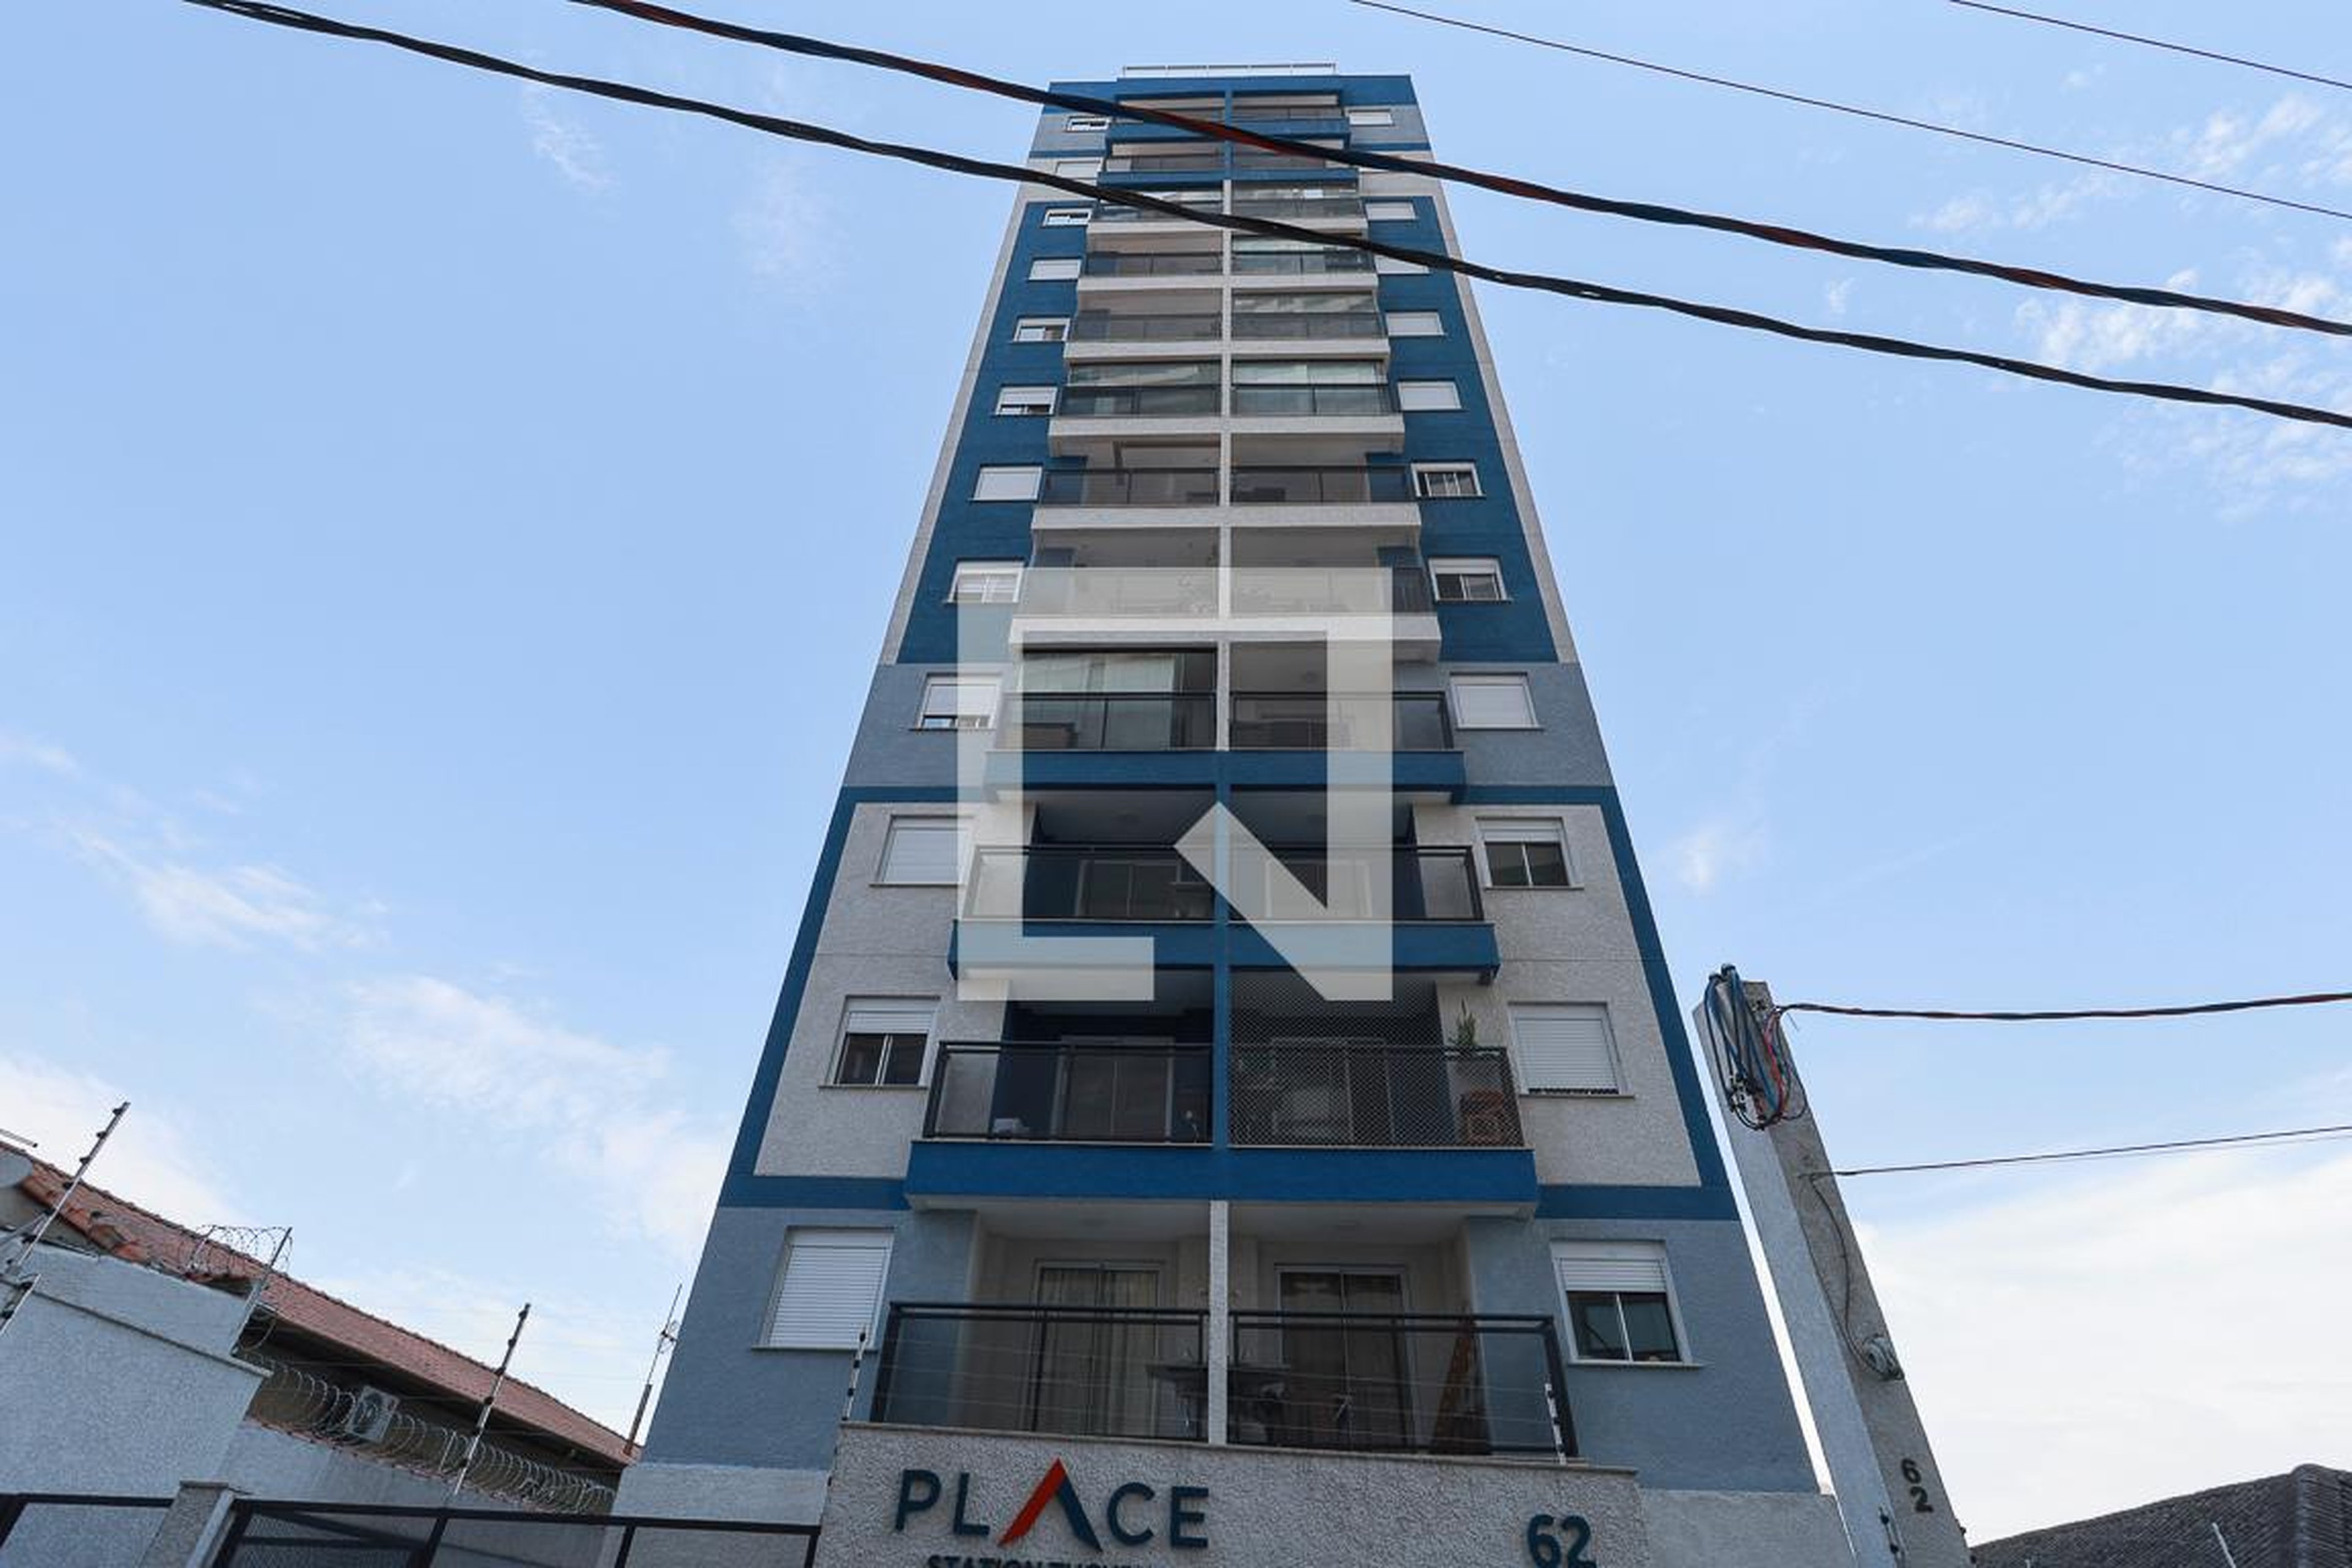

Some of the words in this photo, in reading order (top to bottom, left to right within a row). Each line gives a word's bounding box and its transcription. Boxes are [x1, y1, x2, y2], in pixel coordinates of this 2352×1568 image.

[894, 1457, 1210, 1553] PLACE
[1901, 1458, 1934, 1513] 62
[1527, 1514, 1597, 1568] 62
